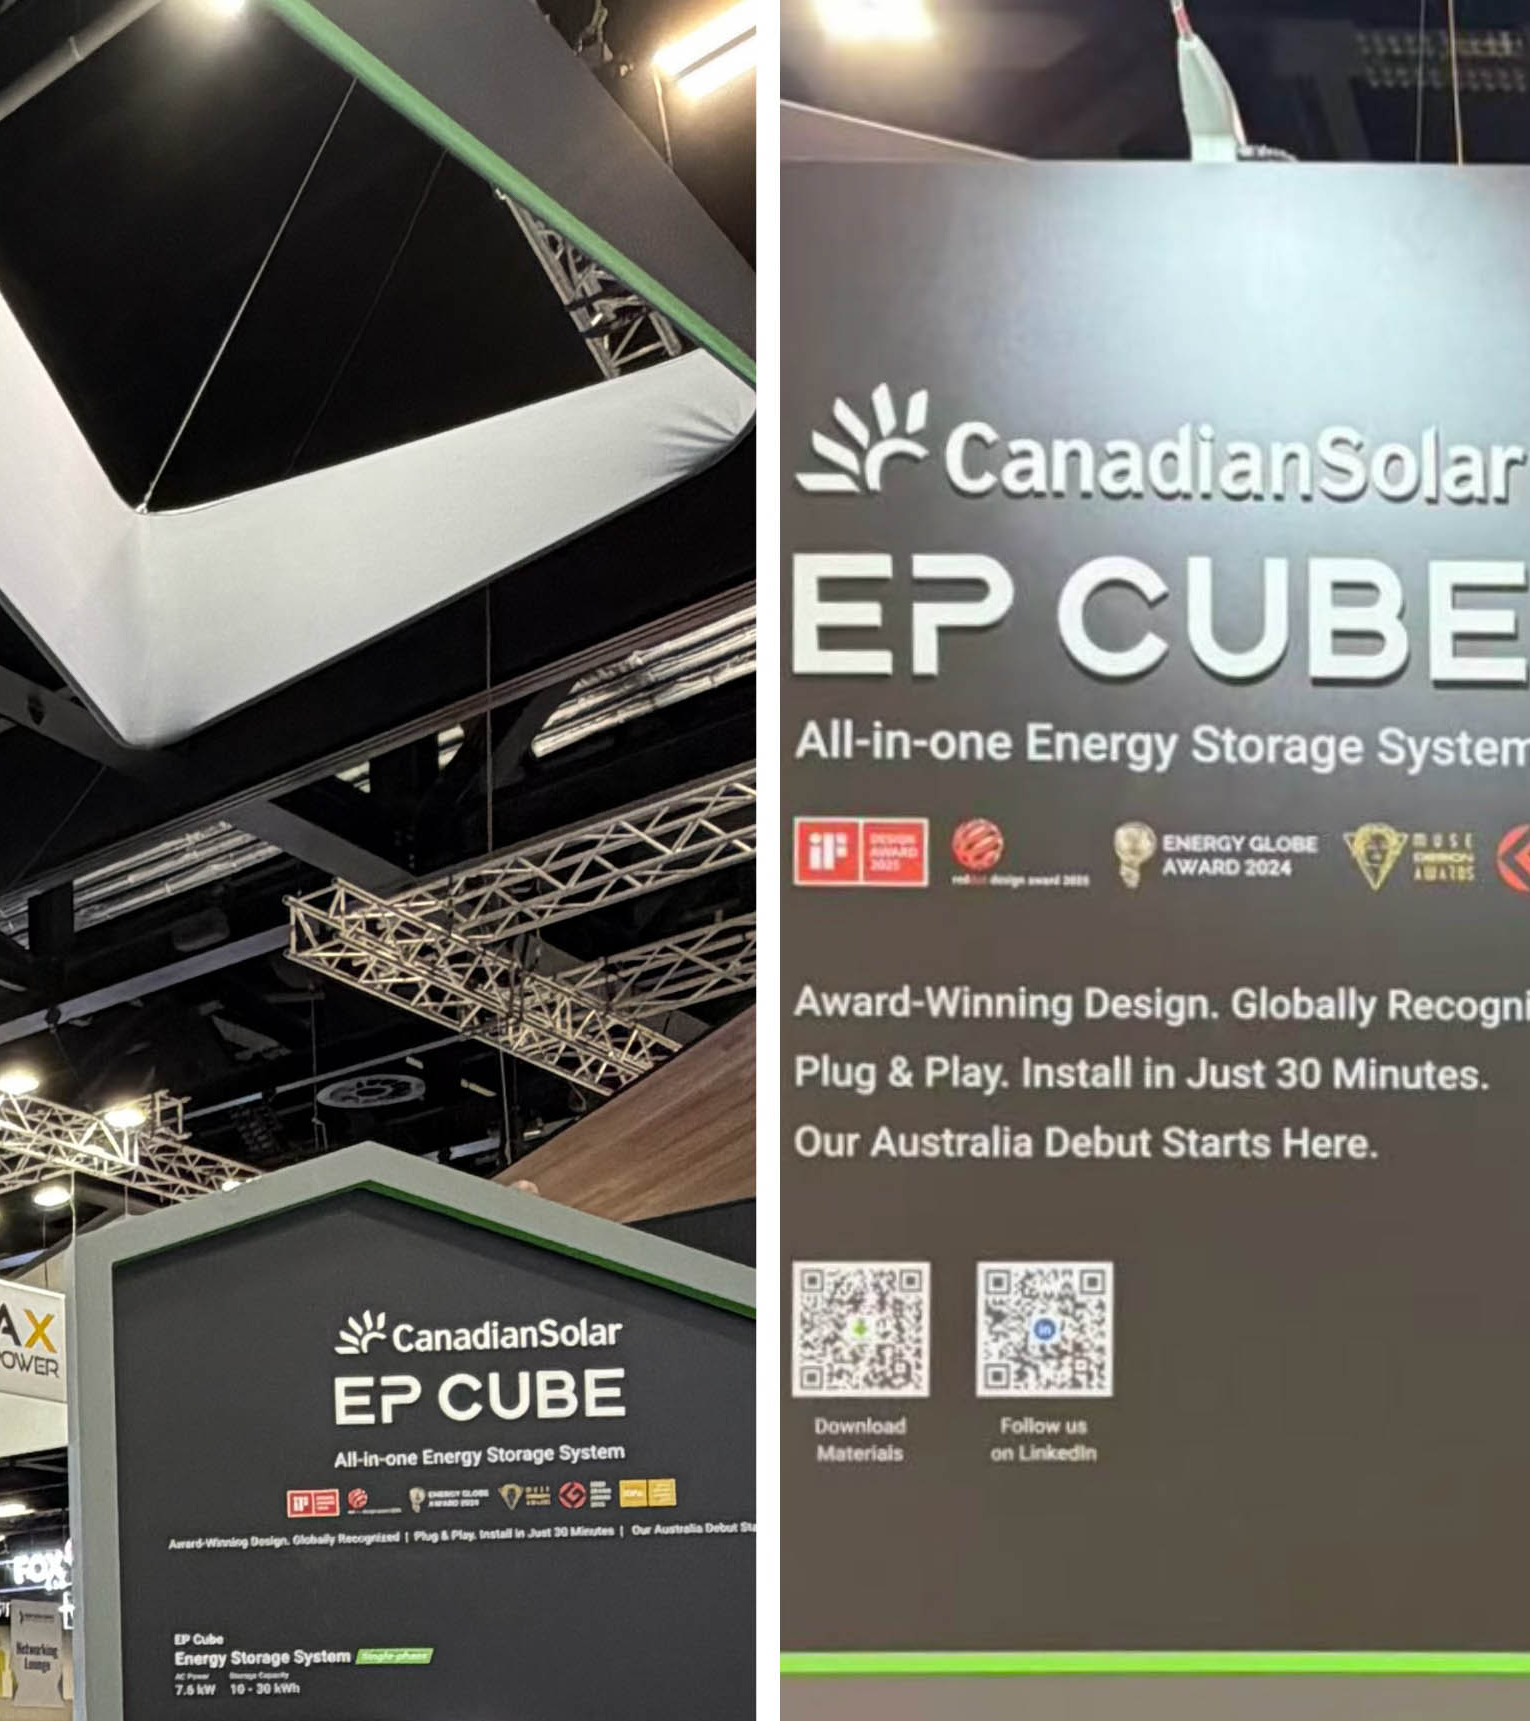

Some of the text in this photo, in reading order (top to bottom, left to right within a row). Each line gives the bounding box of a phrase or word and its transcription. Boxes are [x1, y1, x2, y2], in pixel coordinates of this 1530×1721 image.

[946, 421, 1526, 503] CanadianSolar
[792, 553, 1530, 686] EP CUBE
[795, 718, 1013, 761] All-in-one
[1026, 722, 1180, 773] Energy
[1191, 725, 1365, 773] Storage
[1162, 834, 1318, 854] ENERGY GLOBE
[1162, 857, 1292, 877] AWARD 2024
[793, 984, 1073, 1027] Award-Winning
[1085, 986, 1219, 1027] Design.
[1231, 986, 1378, 1029] Globally
[795, 1053, 1489, 1096] Plug & Play. Install in Just 30 Minutes.
[794, 1124, 1378, 1159] Our Australia Debut Starts Here.
[392, 1317, 624, 1353] CanadianSolar
[334, 1367, 626, 1425] EP CUBE
[814, 1416, 907, 1435] Download
[1000, 1416, 1088, 1435] Follow us
[334, 1443, 626, 1470] All-in-one Energy Storage System
[816, 1444, 904, 1462] Materials
[990, 1443, 1098, 1462] on LinkedIn
[174, 1634, 224, 1646] EP Cube
[174, 1649, 351, 1668] Energy Storage System
